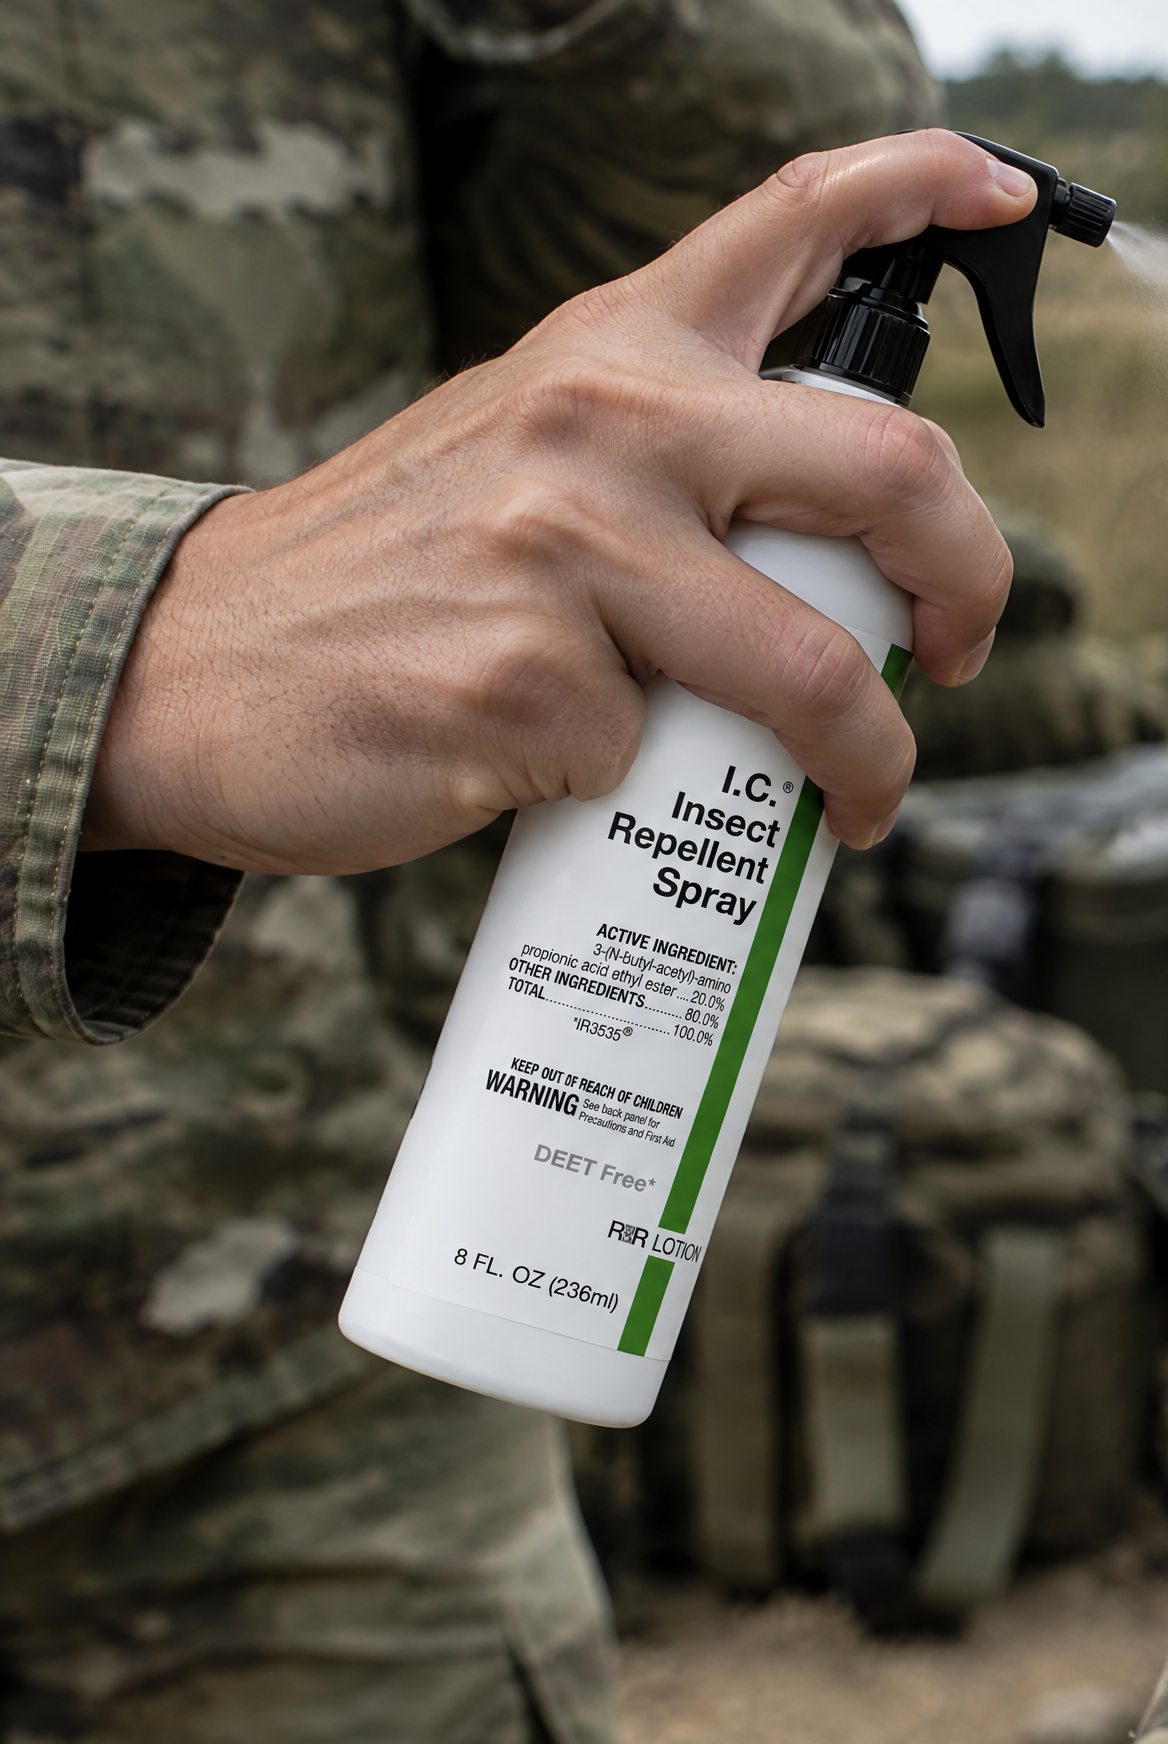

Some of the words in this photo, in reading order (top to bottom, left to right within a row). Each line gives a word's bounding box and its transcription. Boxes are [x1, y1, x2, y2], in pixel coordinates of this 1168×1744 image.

[607, 811, 769, 884] Repellent
[671, 791, 780, 848] Insect
[653, 867, 757, 926] Spray
[521, 944, 579, 969] propionic
[581, 962, 609, 977] acid
[612, 969, 643, 988] ethyl
[690, 990, 725, 1012] 20.0%
[596, 923, 651, 949] ACTIVE
[652, 938, 738, 975] INGREDIENT:
[508, 976, 545, 1000] TOTAL
[673, 1024, 714, 1046] 100.0%
[509, 957, 552, 981] OTHER
[554, 970, 646, 1008] INGREDIENTS
[684, 1007, 719, 1029] 80.0%
[485, 1069, 580, 1117] WARNING
[511, 1057, 540, 1076] KEEP
[541, 1067, 565, 1084] OUT
[564, 1074, 580, 1088] OF
[578, 1078, 616, 1100] REACH
[617, 1089, 633, 1104] OF
[633, 1094, 684, 1119] CHILDREN
[583, 1098, 600, 1112] See
[601, 1103, 622, 1118] back
[623, 1112, 648, 1126] panel
[648, 1117, 660, 1129] for
[578, 1111, 627, 1134] Precautions
[627, 1127, 644, 1139] and
[645, 1130, 663, 1144] First
[662, 1135, 676, 1148] Aid
[534, 1144, 598, 1176] DEET
[652, 1233, 702, 1263] LOTION
[454, 1248, 468, 1266] 8
[472, 1253, 503, 1278] FL.
[512, 1265, 546, 1289] OZ
[548, 1276, 619, 1314] (236ml)
